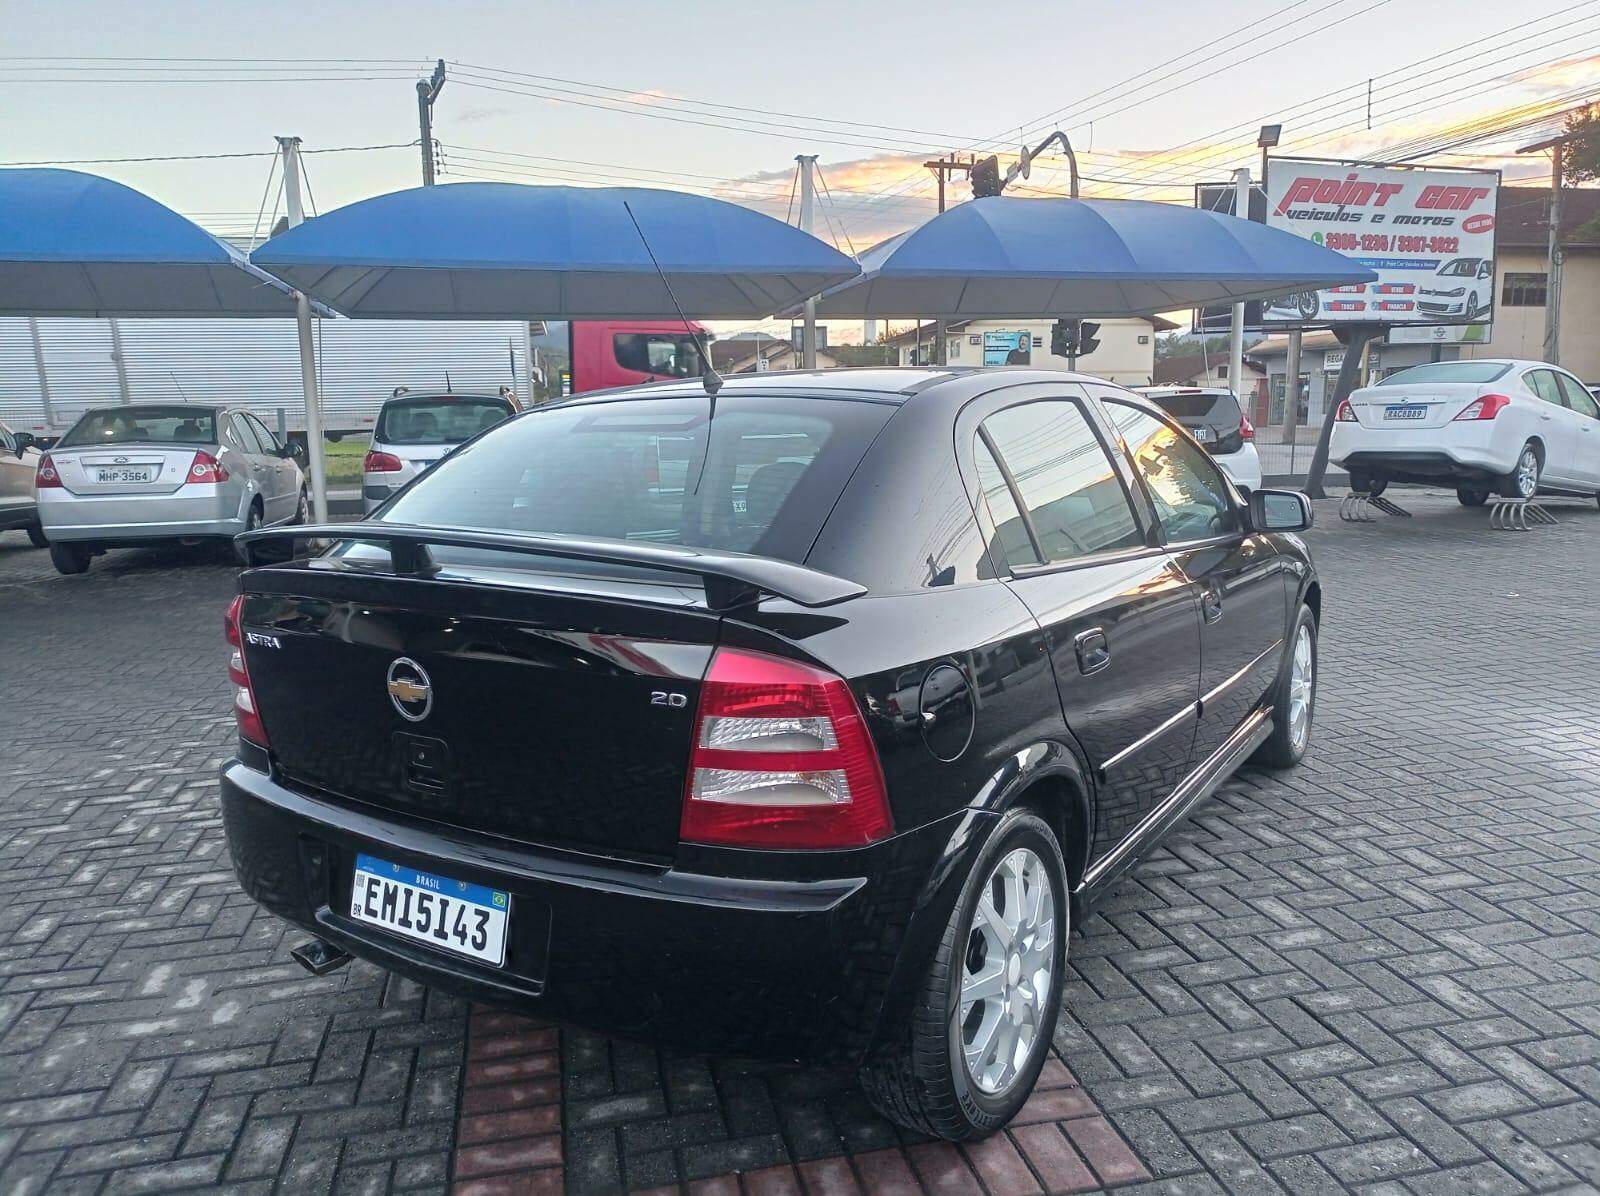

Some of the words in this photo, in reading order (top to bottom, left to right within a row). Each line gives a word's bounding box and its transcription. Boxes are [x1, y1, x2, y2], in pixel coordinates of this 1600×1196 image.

[1371, 214, 1385, 223] e
[246, 632, 281, 649] ASTRA
[415, 874, 441, 890] BRASIL
